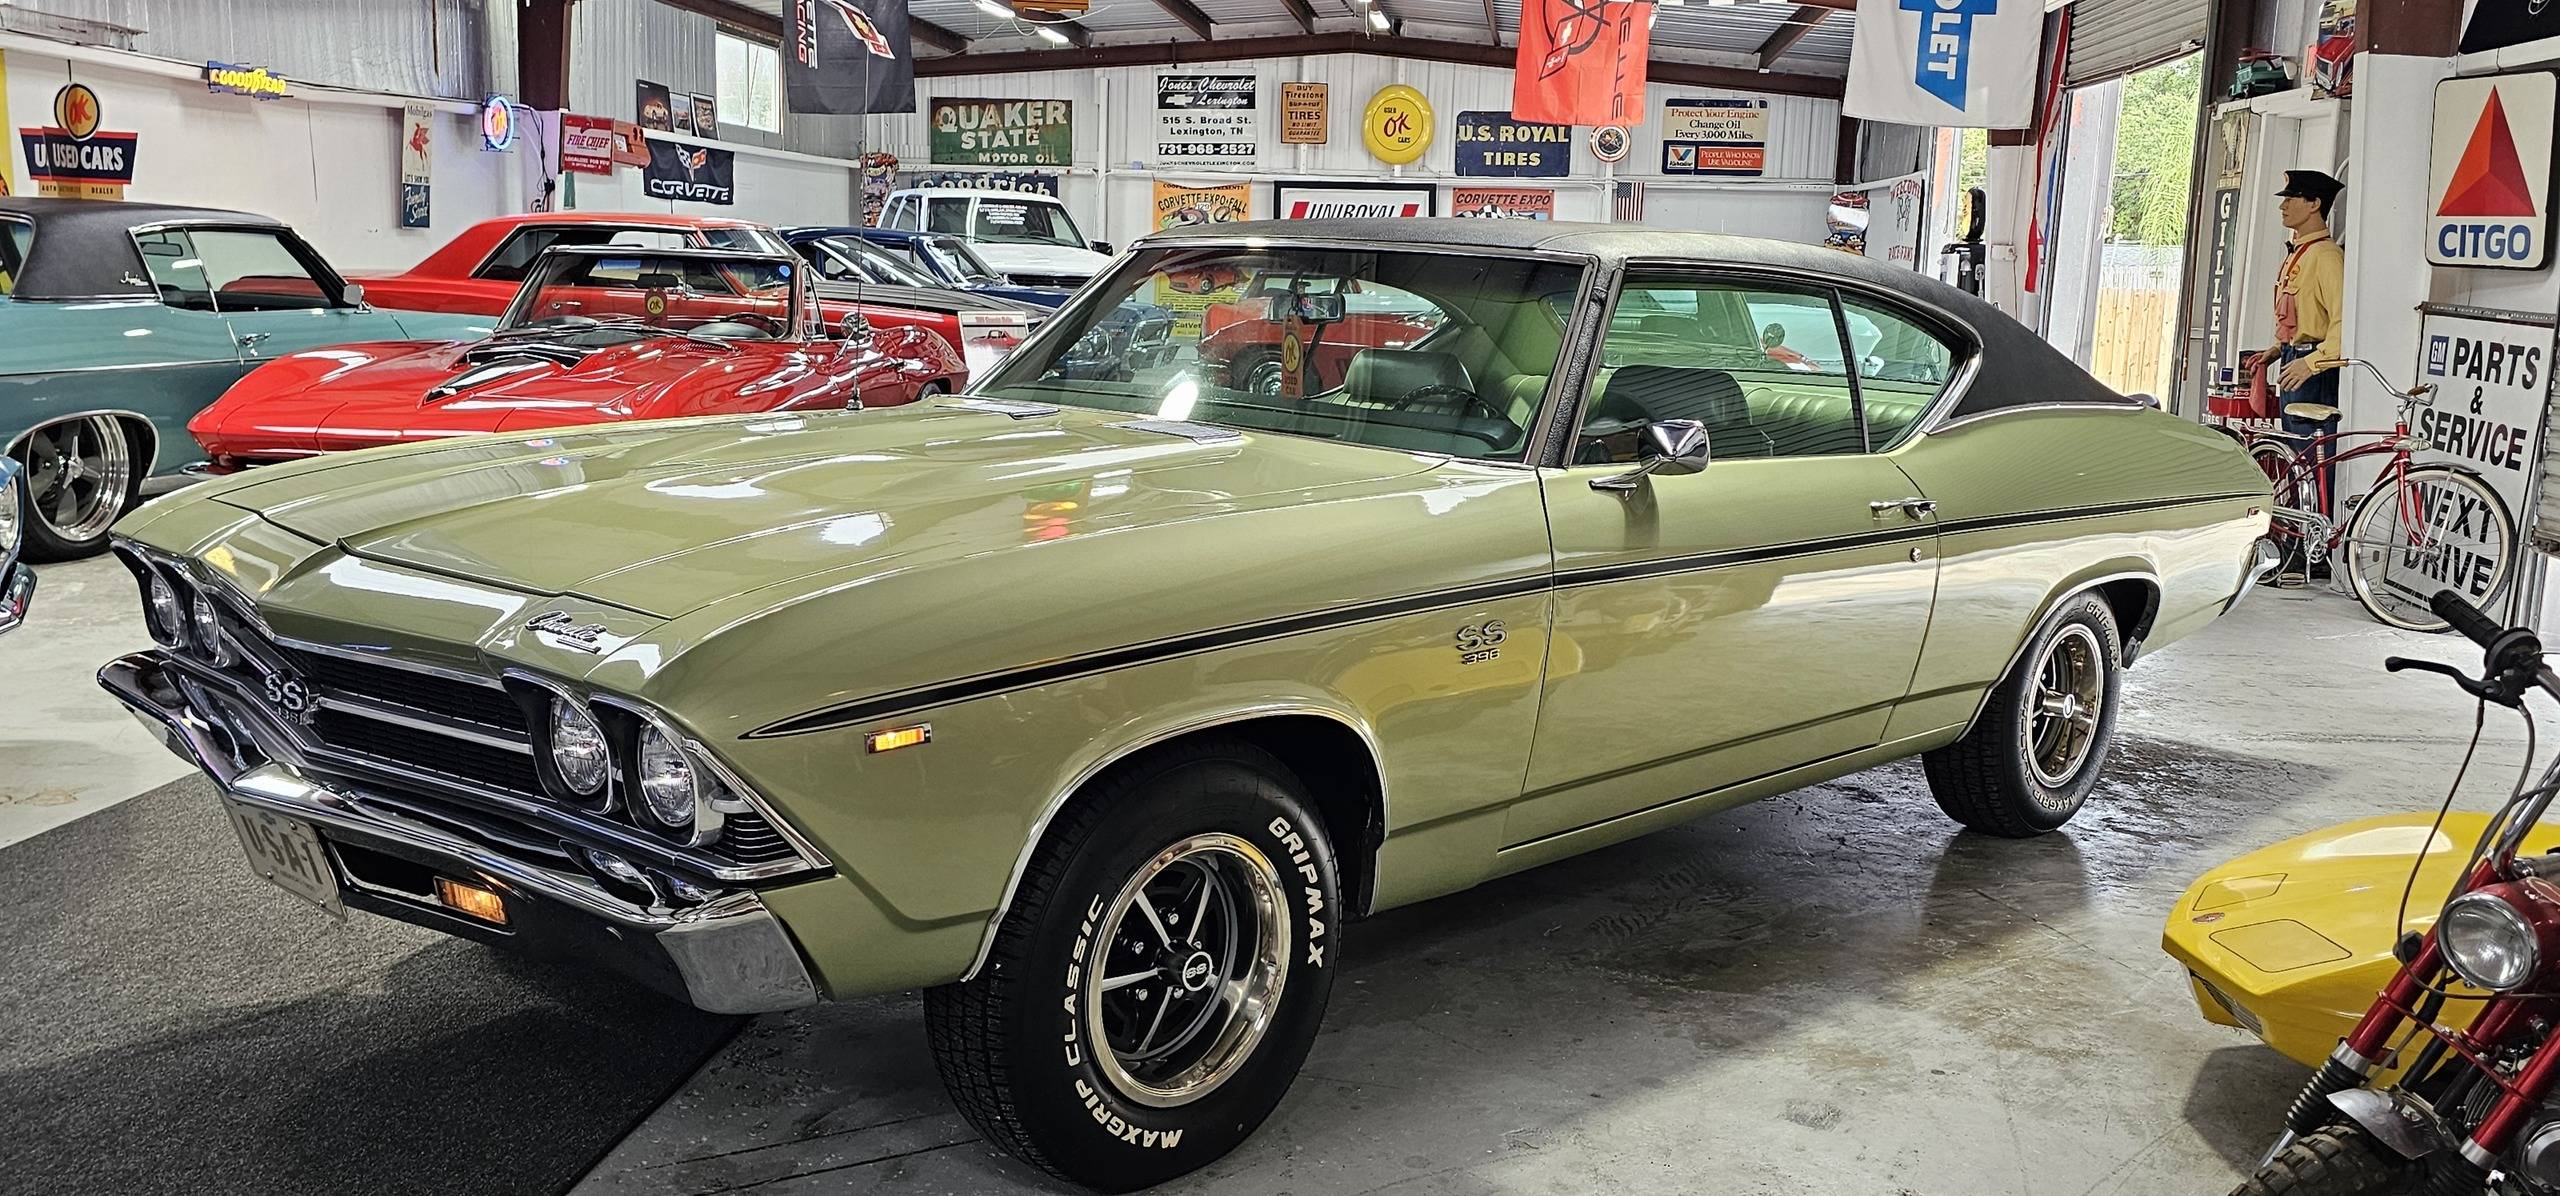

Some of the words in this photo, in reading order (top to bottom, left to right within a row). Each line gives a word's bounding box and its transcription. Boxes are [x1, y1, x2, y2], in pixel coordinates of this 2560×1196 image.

[797, 0, 807, 63] CING
[1159, 77, 1193, 94] Jones
[1198, 77, 1255, 94] Chevrolet
[1285, 91, 1324, 99] Firestone
[70, 93, 92, 126] OK
[1197, 94, 1248, 108] Lexington
[407, 105, 433, 119] Mobilgas
[935, 101, 1067, 133] QUAKER
[1288, 111, 1321, 120] TIRES
[1671, 109, 1702, 117] Protect
[1704, 109, 1724, 117] Your
[1727, 109, 1759, 119] Engine
[1170, 127, 1226, 136] Lexington,
[1230, 127, 1243, 135] TN
[1384, 111, 1411, 137] OK
[1458, 125, 1495, 142] U.S.
[1500, 125, 1569, 143] ROYAL
[1675, 129, 1700, 139] Every
[1728, 131, 1753, 139] Miles
[1689, 120, 1724, 129] Change
[1726, 120, 1740, 128] Oil
[567, 134, 586, 146] FIRE
[586, 136, 610, 148] CHIEF
[961, 129, 1040, 149] STATE
[1160, 144, 1254, 154] 731-968-2527
[52, 143, 79, 168] USED
[80, 145, 124, 171] CARS
[979, 152, 1029, 163] MOTOR
[1035, 153, 1059, 164] OIL
[1483, 152, 1541, 166] TIRES
[651, 179, 730, 200] CORVETTE
[1456, 193, 1517, 204] CORVETTE
[1519, 195, 1550, 205] EXPO
[1158, 193, 1201, 211] CORVETTE
[2438, 224, 2531, 260] CITGO
[2431, 340, 2446, 363] GM
[2452, 337, 2541, 390] PARTS
[2469, 385, 2483, 415] &
[2419, 408, 2527, 471] SERVICE
[2420, 482, 2493, 544] NEXT
[2403, 534, 2494, 598] DRIVE
[1456, 620, 1508, 651] SS
[1461, 648, 1500, 665] 396
[265, 673, 302, 710] SS
[240, 815, 323, 884] USA-1
[1268, 816, 1325, 969] GRIPMAX
[1064, 893, 1104, 1067] CLASSIC
[1186, 963, 1207, 979] SS
[1075, 1079, 1183, 1149] MAXGRIP
